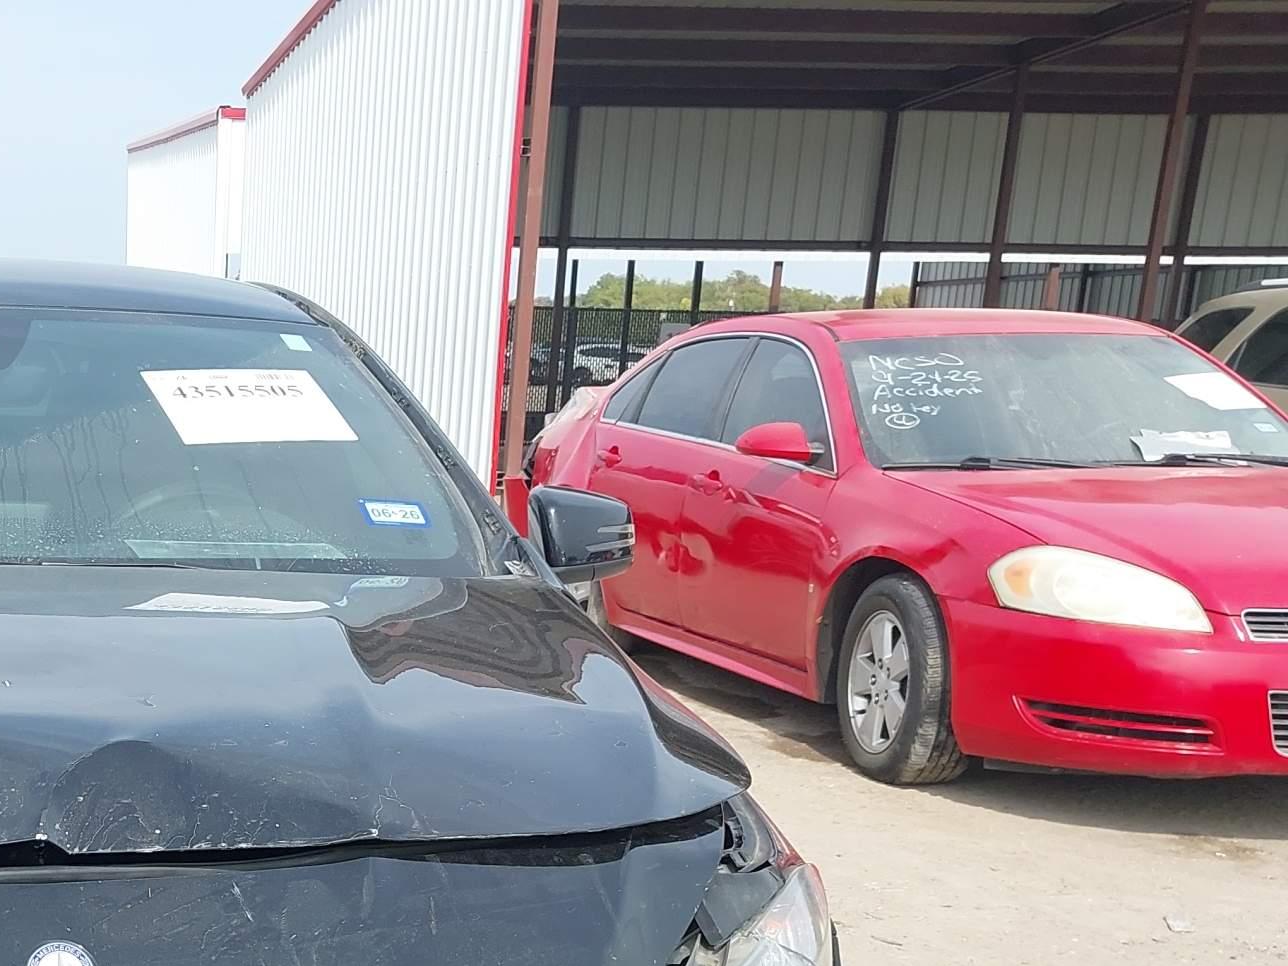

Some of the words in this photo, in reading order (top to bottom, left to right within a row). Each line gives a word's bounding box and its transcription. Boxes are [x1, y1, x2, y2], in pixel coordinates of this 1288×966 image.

[868, 352, 964, 370] NCSO
[172, 385, 304, 398] 43515505
[873, 383, 983, 400] Accident
[371, 507, 421, 520] 06-26
